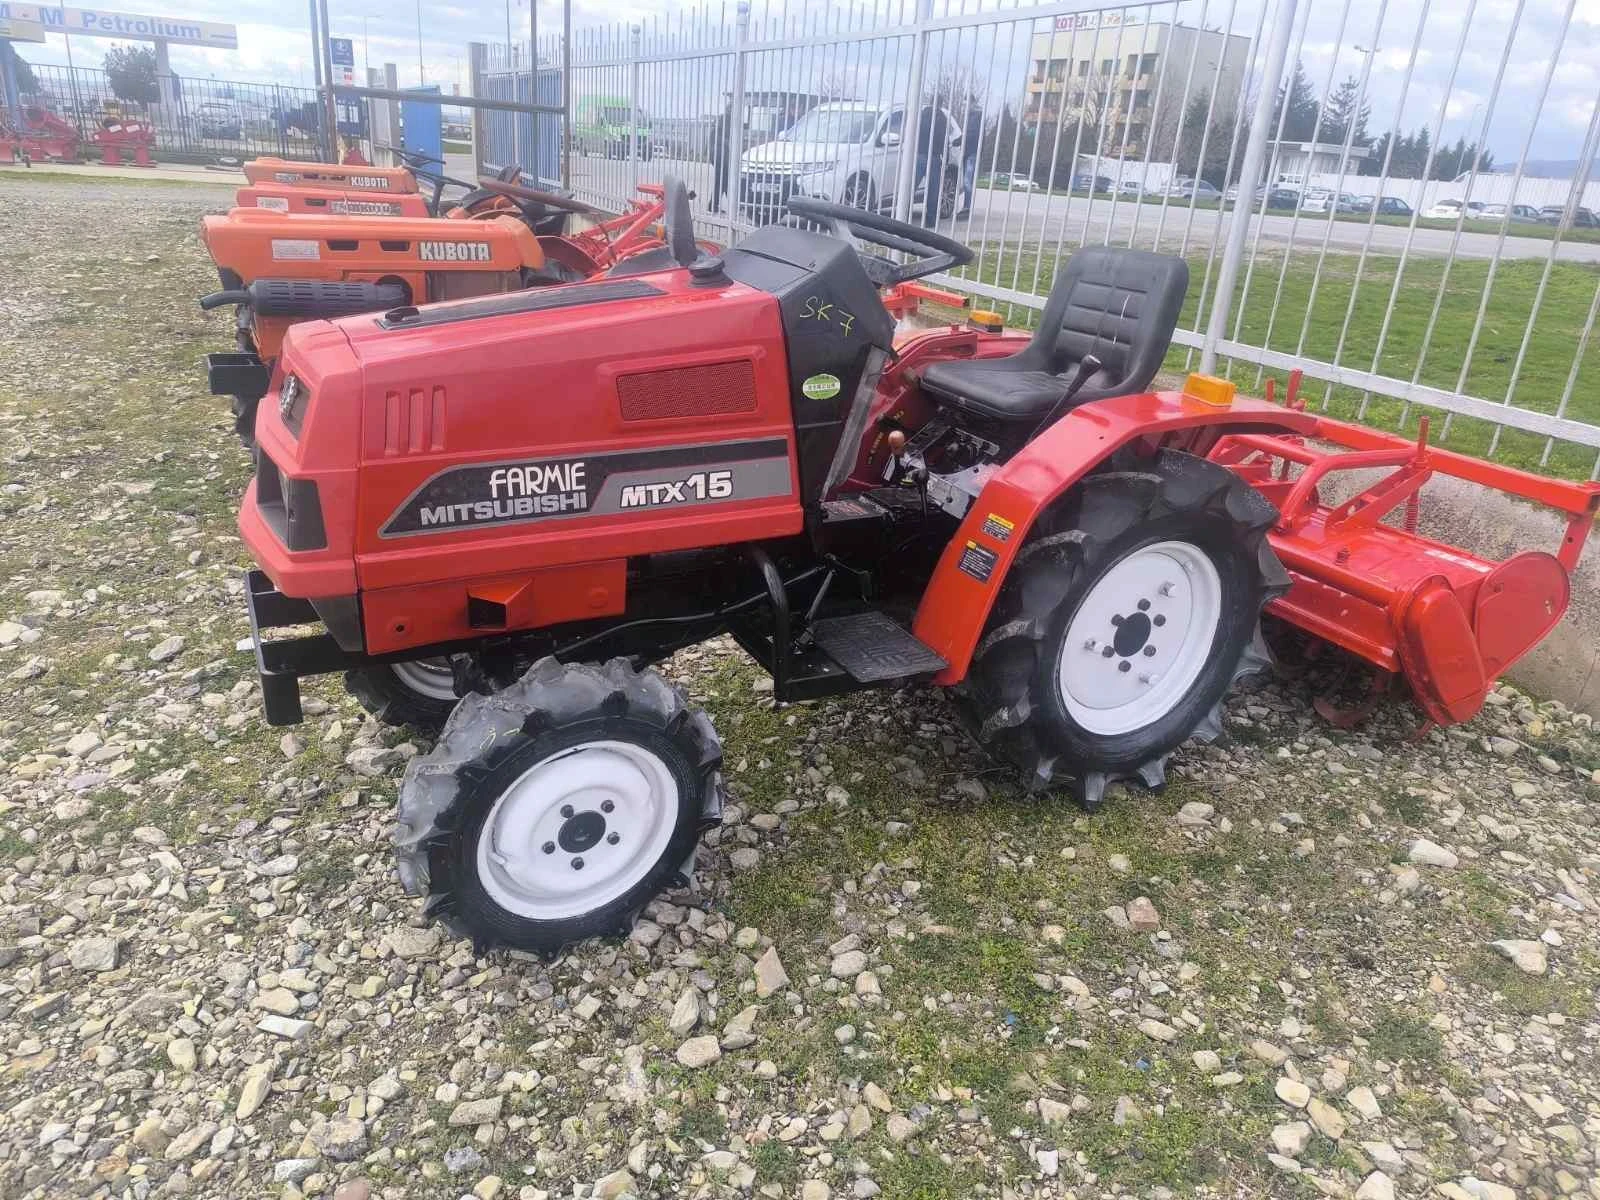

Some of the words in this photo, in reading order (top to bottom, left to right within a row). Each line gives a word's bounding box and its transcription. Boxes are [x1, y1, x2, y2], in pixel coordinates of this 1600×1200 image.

[39, 7, 65, 25] M
[81, 12, 200, 39] Petrolium
[350, 176, 388, 189] KUBOTA
[419, 242, 490, 261] KUBOTA
[489, 462, 586, 498] FARMIE
[621, 471, 734, 509] MTX15
[419, 492, 588, 527] MITSUBISHI
